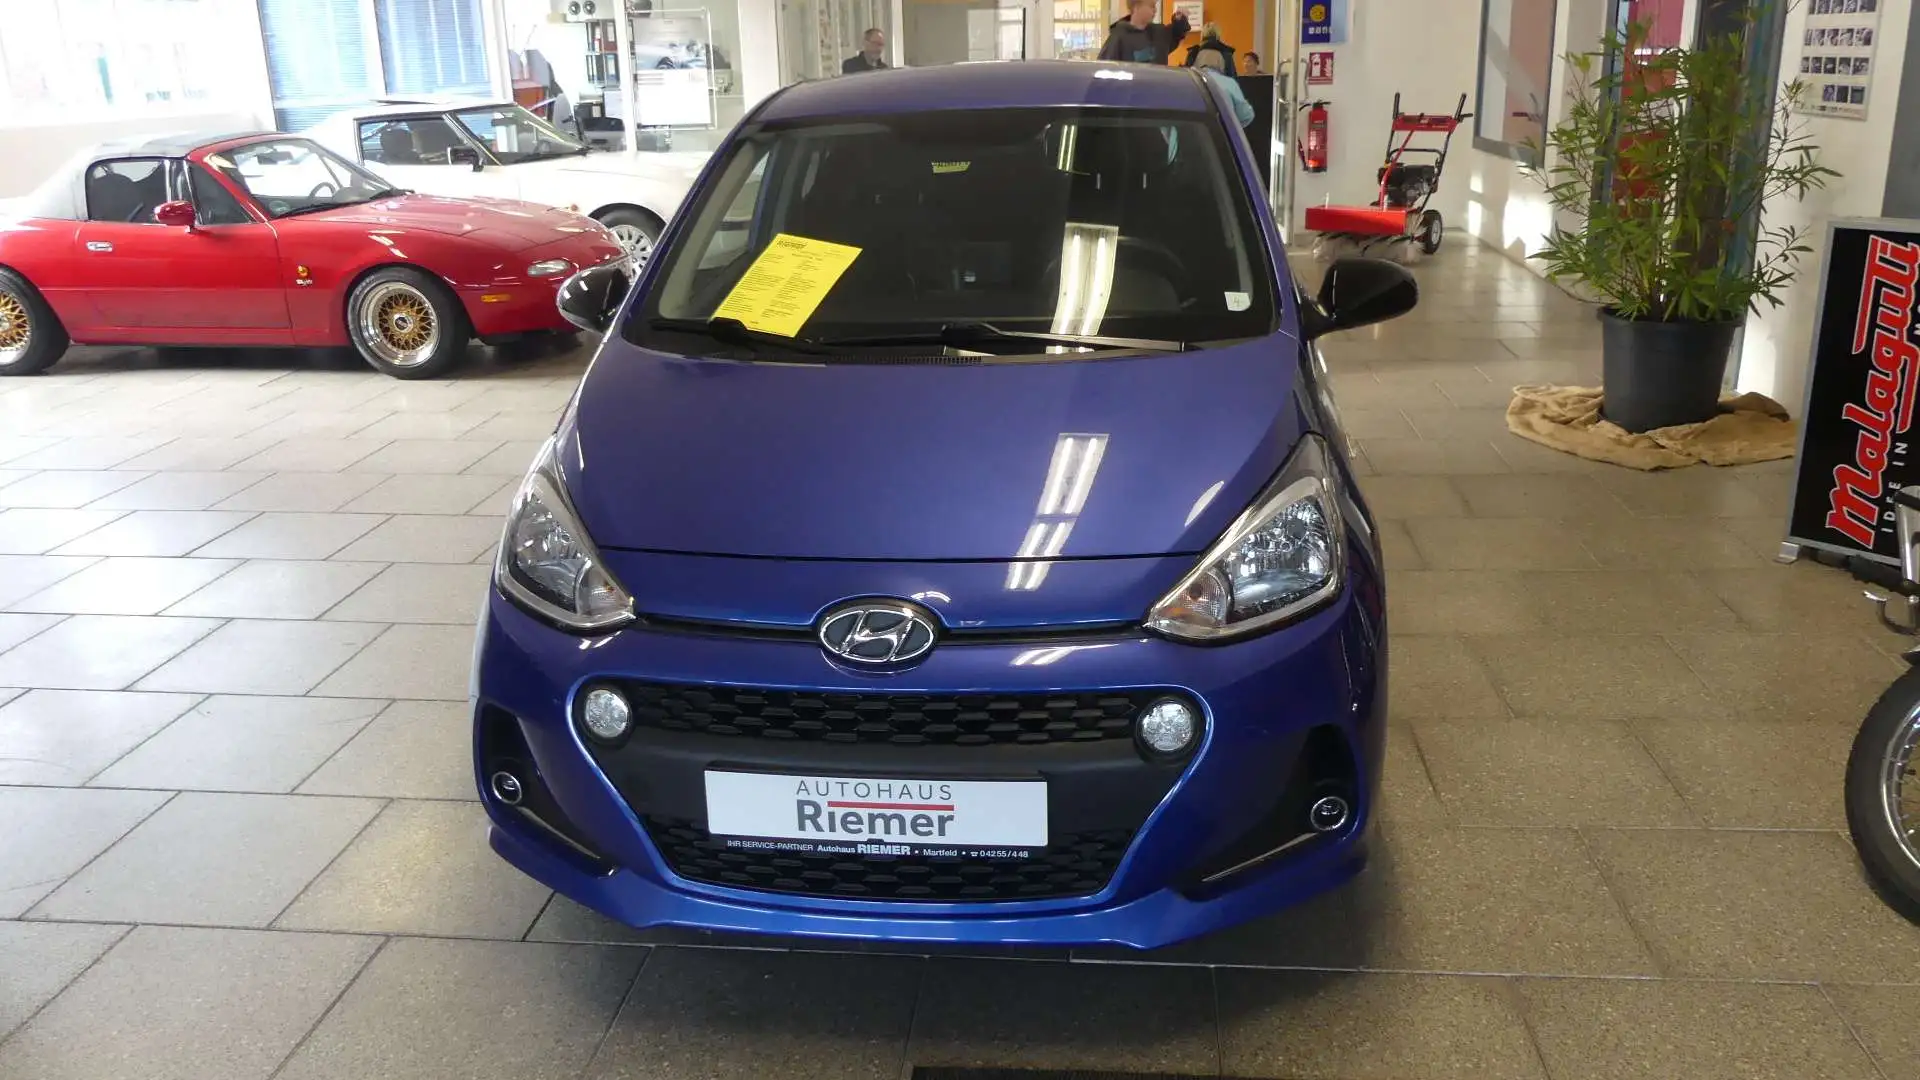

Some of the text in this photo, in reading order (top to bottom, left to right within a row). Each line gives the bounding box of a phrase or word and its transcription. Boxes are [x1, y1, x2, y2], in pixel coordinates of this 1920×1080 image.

[1892, 442, 1908, 467] IN
[796, 779, 953, 800] AUTOHAUS
[796, 799, 954, 837] Riemer
[727, 839, 742, 848] IHR
[742, 840, 814, 851] SERVICE-PARTNER
[817, 844, 856, 854] Autohaus
[857, 844, 911, 855] RIEMER
[923, 848, 958, 857] Martfeld
